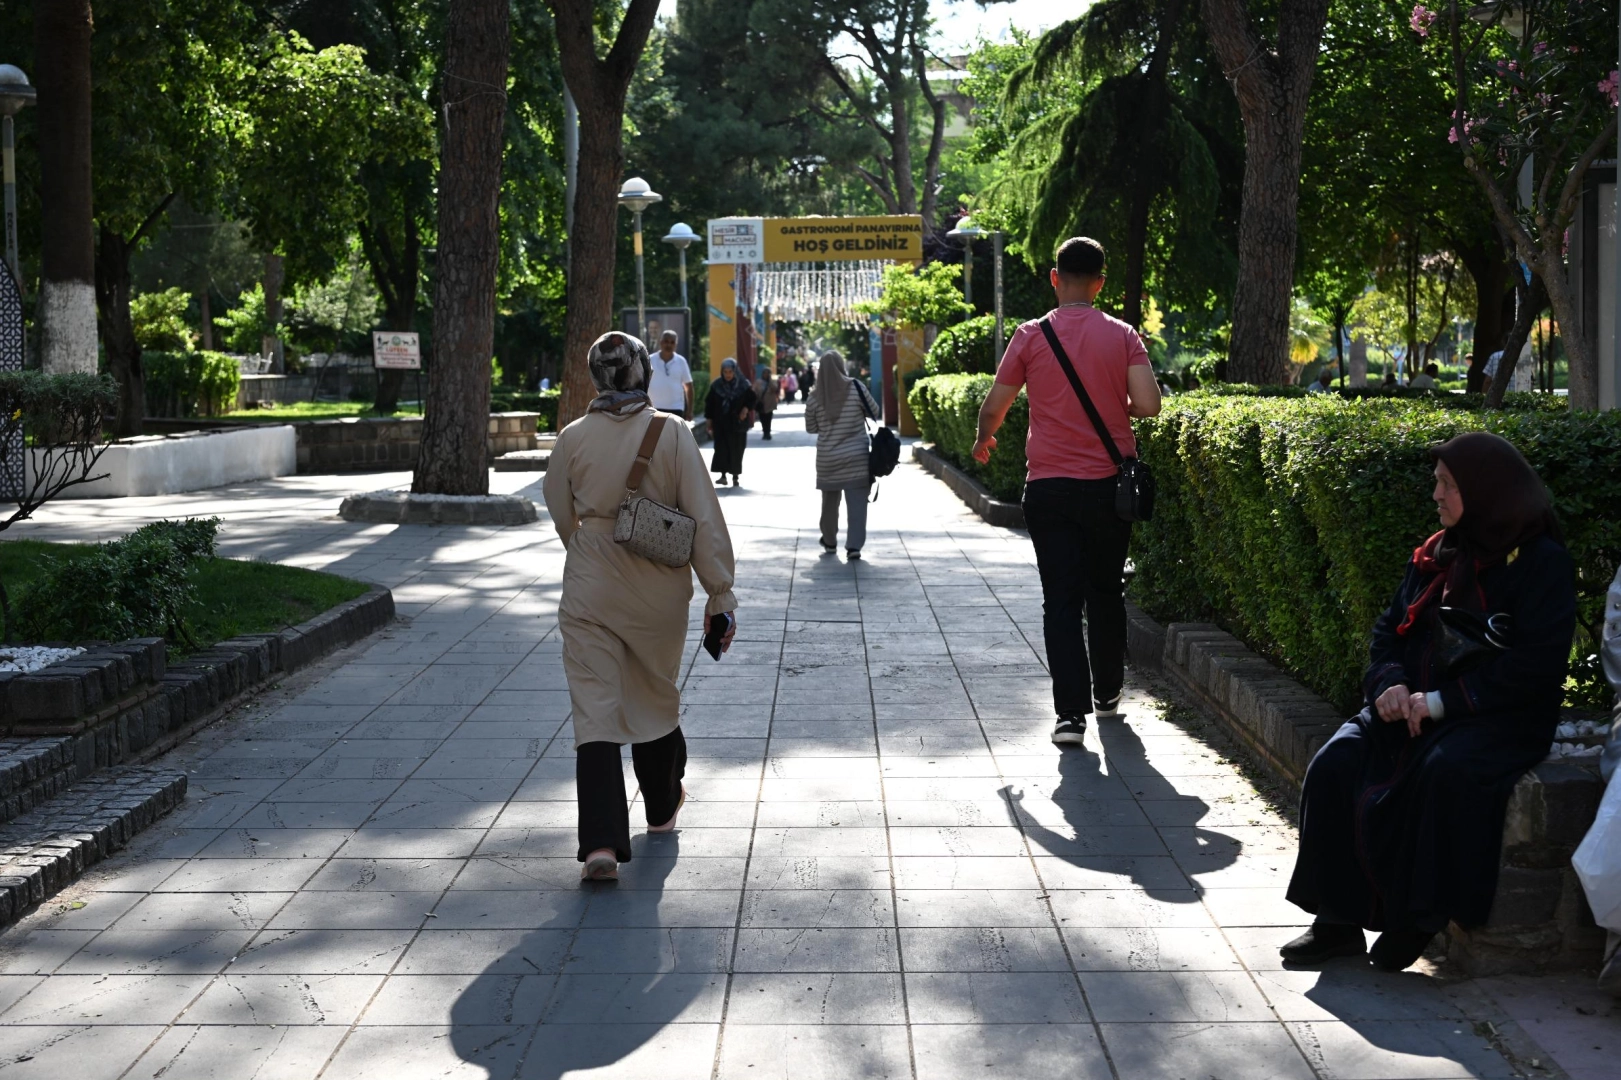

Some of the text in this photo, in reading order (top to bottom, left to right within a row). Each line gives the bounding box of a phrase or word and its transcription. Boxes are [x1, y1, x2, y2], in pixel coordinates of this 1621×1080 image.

[780, 223, 921, 235] GASTRONOMİ PANAYIRINA
[793, 234, 908, 254] HOŞ GELDİNİZ
